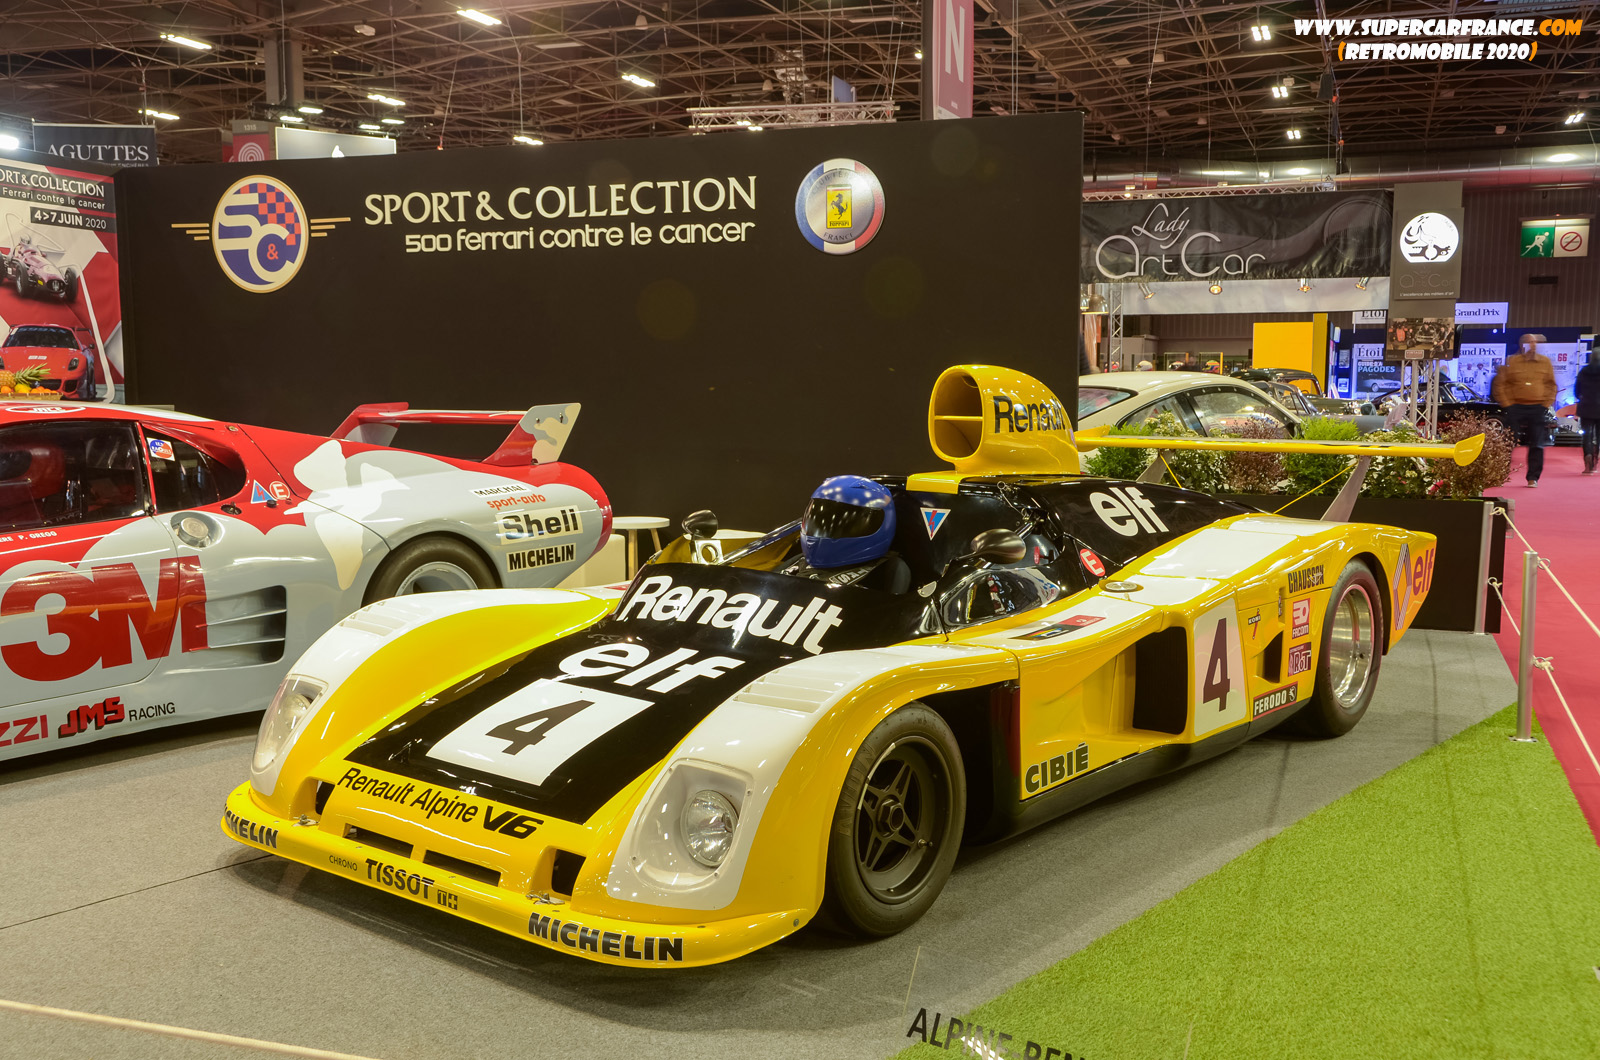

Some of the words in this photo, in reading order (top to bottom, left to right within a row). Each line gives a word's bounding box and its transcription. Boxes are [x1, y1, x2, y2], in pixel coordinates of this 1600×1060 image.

[48, 144, 149, 161] AGUTTES
[2, 187, 33, 200] Ferrari
[36, 192, 65, 204] contre
[67, 196, 76, 206] le
[78, 200, 106, 210] cancer
[58, 213, 83, 226] JUIN
[85, 218, 107, 230] 2020
[405, 233, 453, 253] 500
[456, 226, 535, 251] ferrari
[539, 223, 624, 249] contre
[630, 222, 653, 246] le
[659, 221, 756, 245] cancer
[1131, 202, 1190, 249] Lady
[1455, 308, 1480, 316] Grand
[1482, 308, 1500, 316] Prix
[1479, 347, 1497, 355] Prix
[1557, 353, 1568, 362] 66
[486, 493, 547, 511] sport-auto
[1088, 487, 1170, 538] elf
[502, 508, 579, 540] Shell
[508, 544, 575, 571] MICHELIN
[1412, 548, 1435, 596] elf
[0, 556, 209, 682] 3M
[621, 575, 844, 656] Renault
[556, 642, 745, 694] elf
[1202, 617, 1231, 713] 4
[58, 696, 126, 739] JMS
[129, 702, 176, 721] RACING
[1254, 689, 1287, 716] FERODO
[485, 700, 595, 756] 4
[1024, 743, 1089, 795] CIBIÉ
[337, 768, 415, 805] Renault
[410, 788, 479, 823] Alpine
[483, 805, 545, 840] V6
[328, 855, 358, 872] CHRONO
[365, 858, 435, 899] TISSOT
[528, 912, 684, 962] MICHELIN
